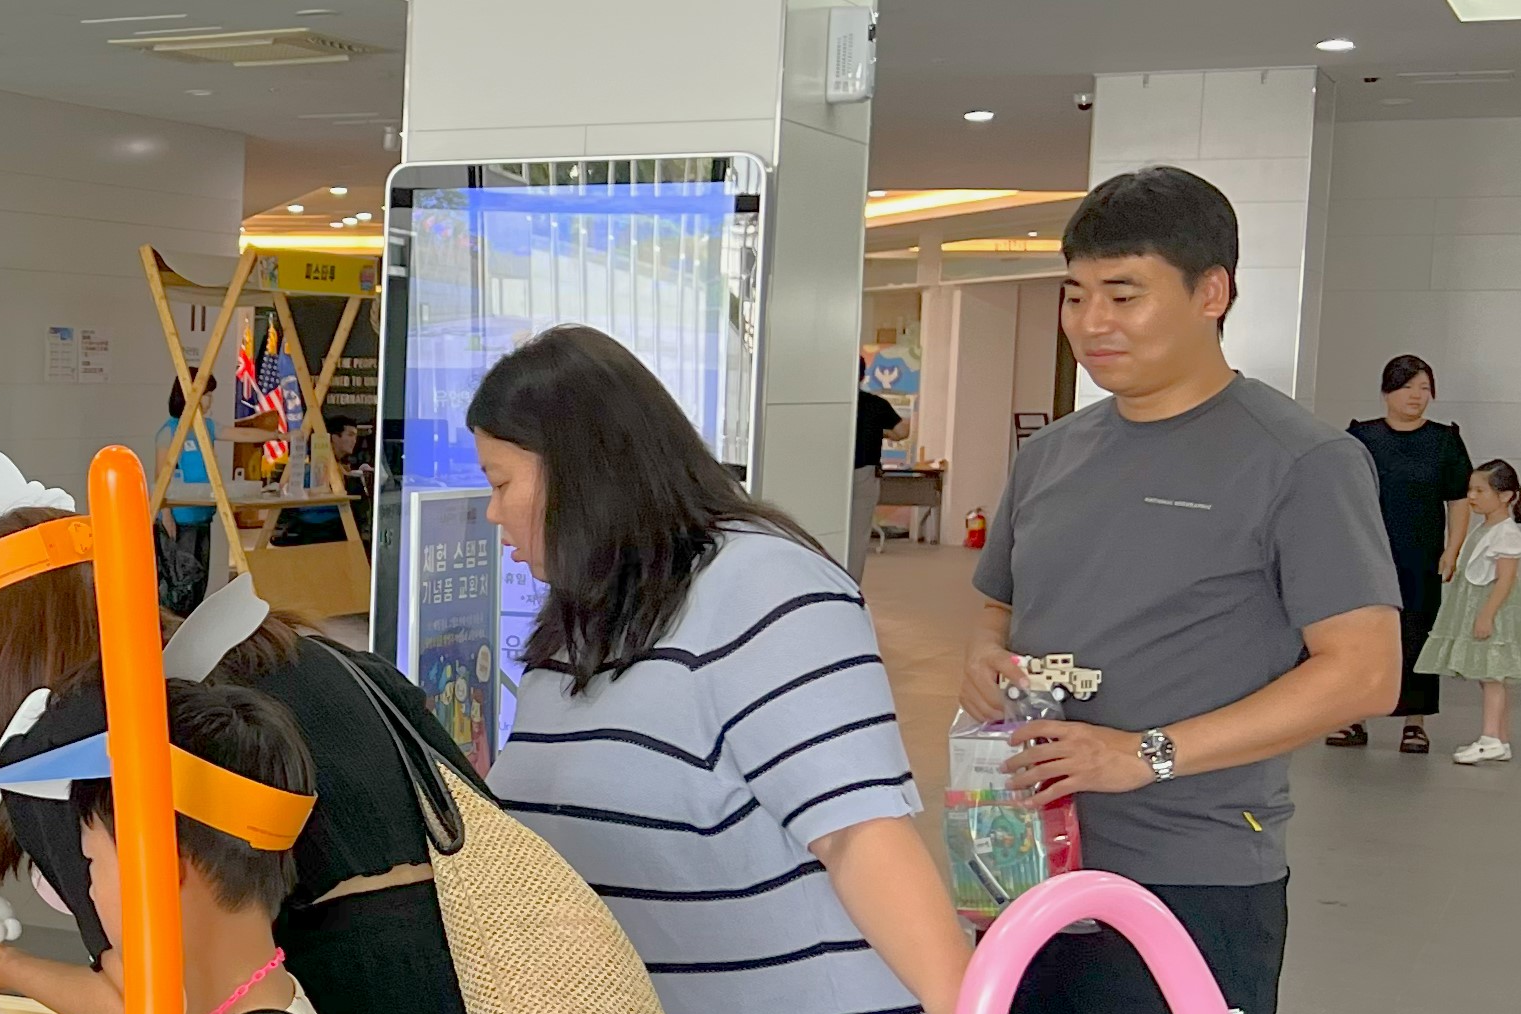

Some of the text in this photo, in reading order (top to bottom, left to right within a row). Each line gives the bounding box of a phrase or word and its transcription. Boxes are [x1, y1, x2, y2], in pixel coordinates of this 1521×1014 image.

[423, 538, 488, 574] 체험 스탬프
[422, 573, 489, 605] 기념품 교환처
[504, 573, 527, 586] 휴일
